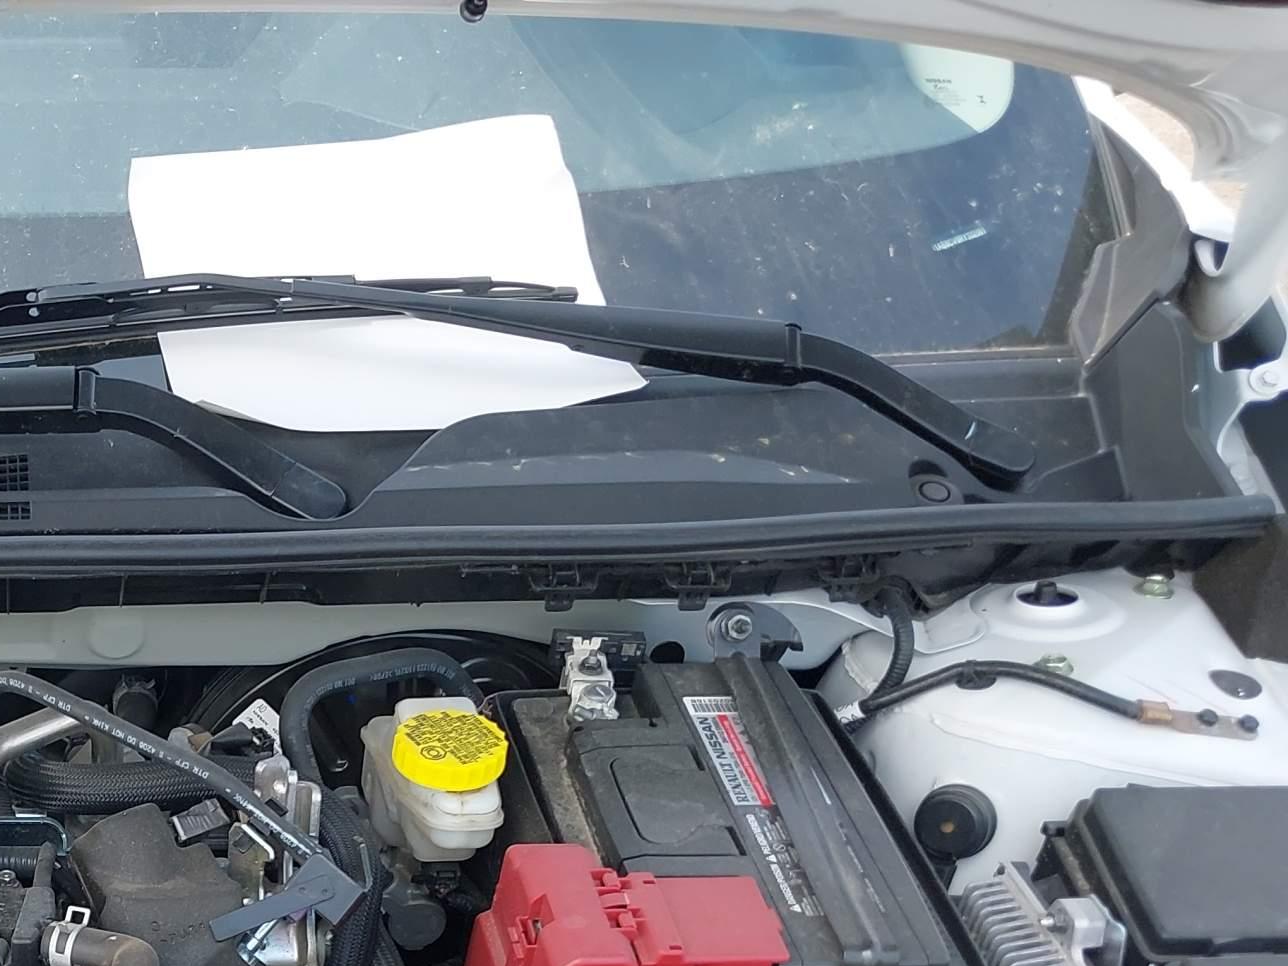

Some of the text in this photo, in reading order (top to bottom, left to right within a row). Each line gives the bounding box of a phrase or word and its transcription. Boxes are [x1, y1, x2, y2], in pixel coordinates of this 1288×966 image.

[697, 715, 728, 760] NISSAN
[193, 768, 210, 780] DTR
[720, 762, 749, 804] RENAULT
